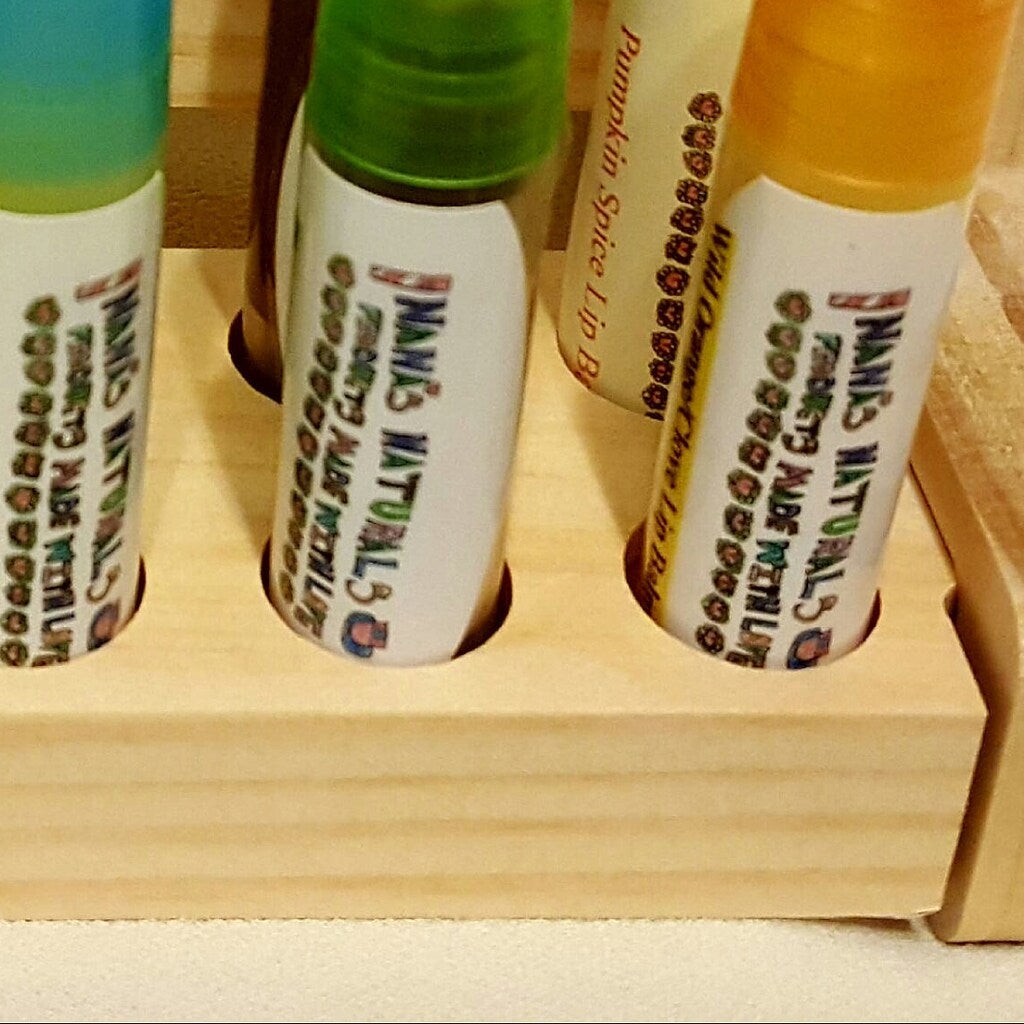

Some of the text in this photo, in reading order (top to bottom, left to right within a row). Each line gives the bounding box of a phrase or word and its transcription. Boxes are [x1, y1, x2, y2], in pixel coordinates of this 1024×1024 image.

[601, 25, 641, 178] Pumpkin
[588, 183, 620, 278] Spice
[577, 281, 607, 340] Lip
[345, 427, 429, 605] NATURALS
[792, 443, 879, 623] NATURALS
